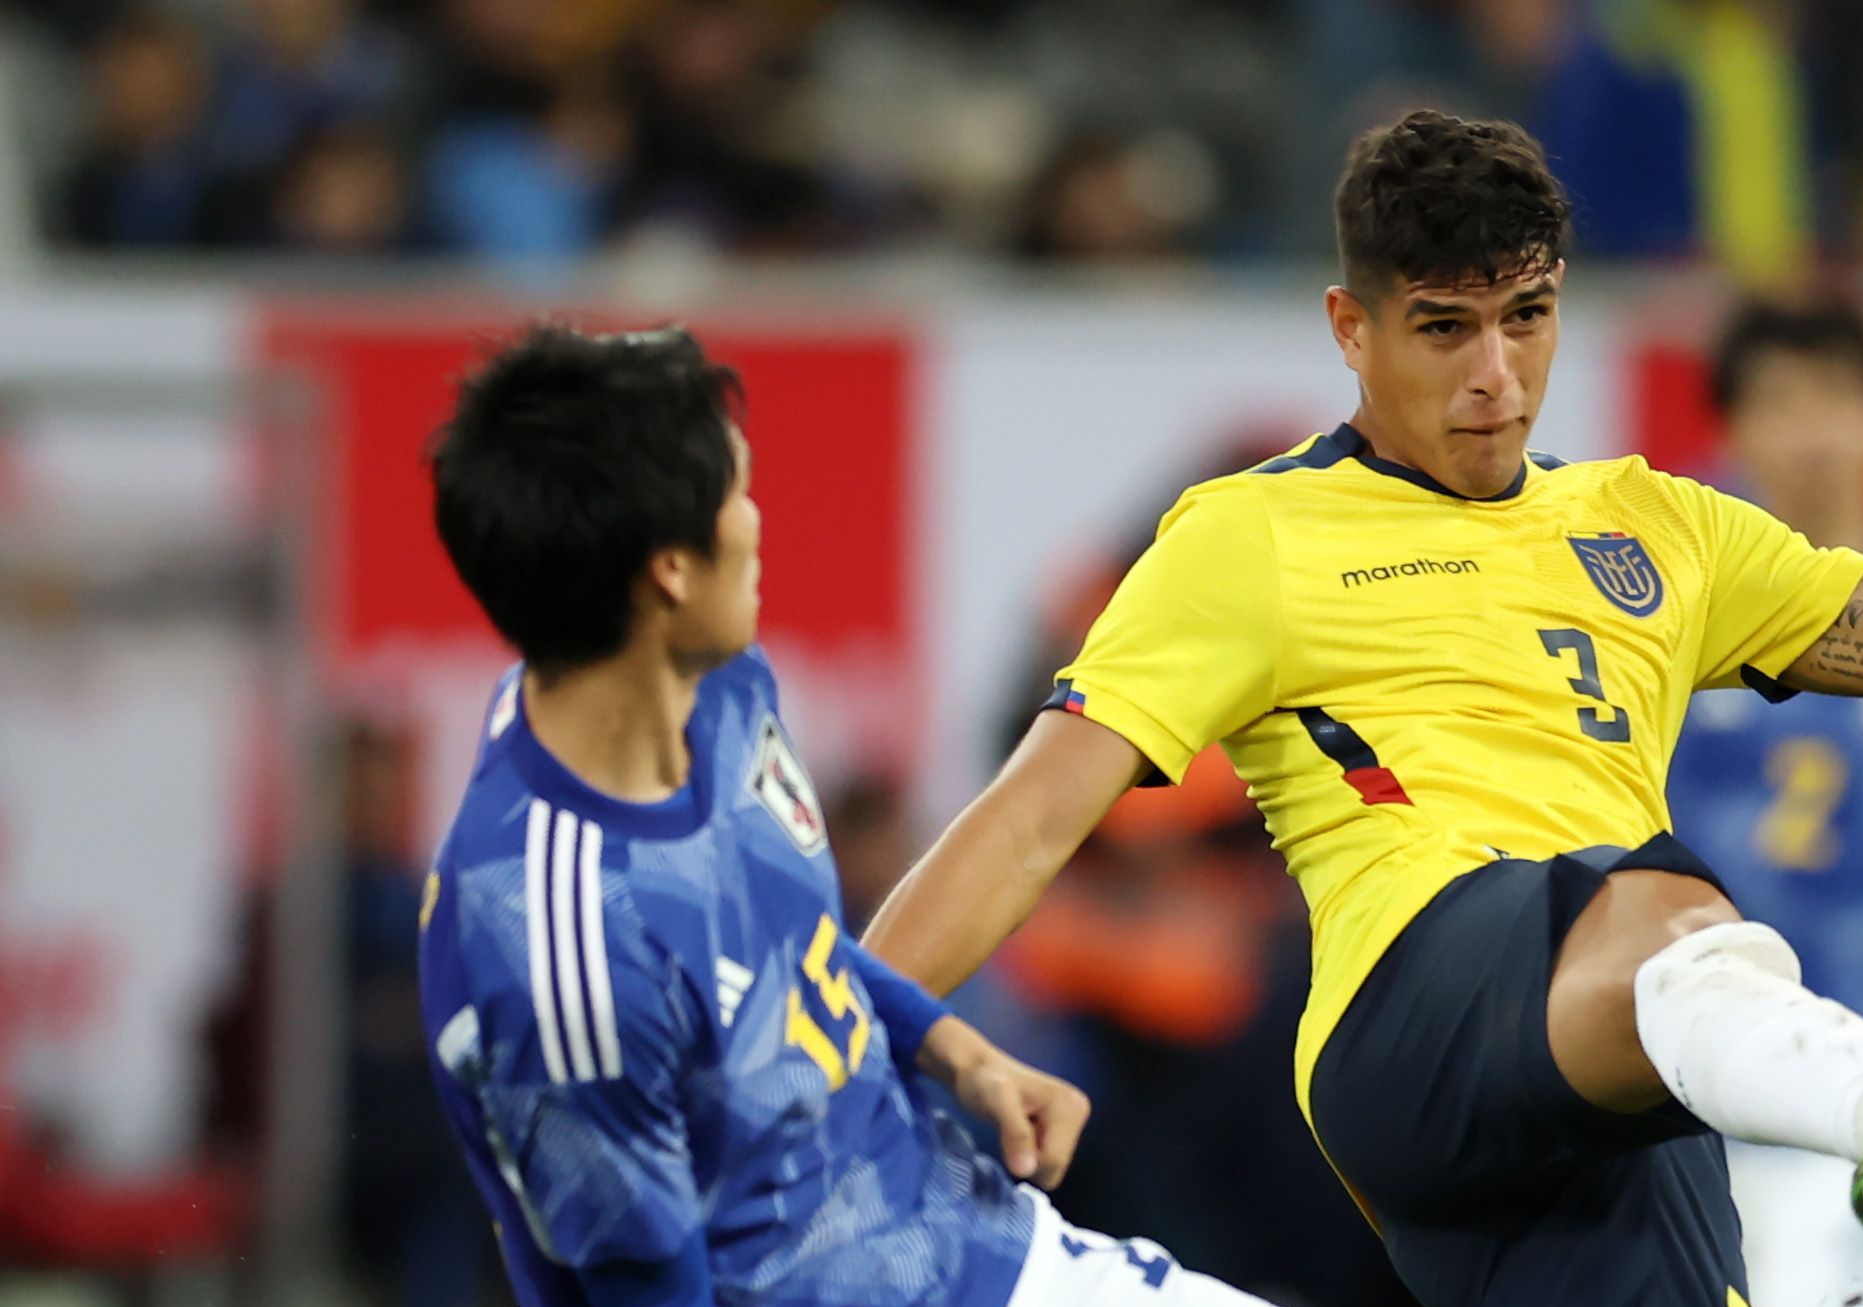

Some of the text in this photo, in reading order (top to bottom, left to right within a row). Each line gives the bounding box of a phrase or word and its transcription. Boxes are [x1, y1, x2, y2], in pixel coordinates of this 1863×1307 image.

[1341, 558, 1480, 588] marathon
[1537, 628, 1630, 743] 3
[784, 912, 870, 1092] 15
